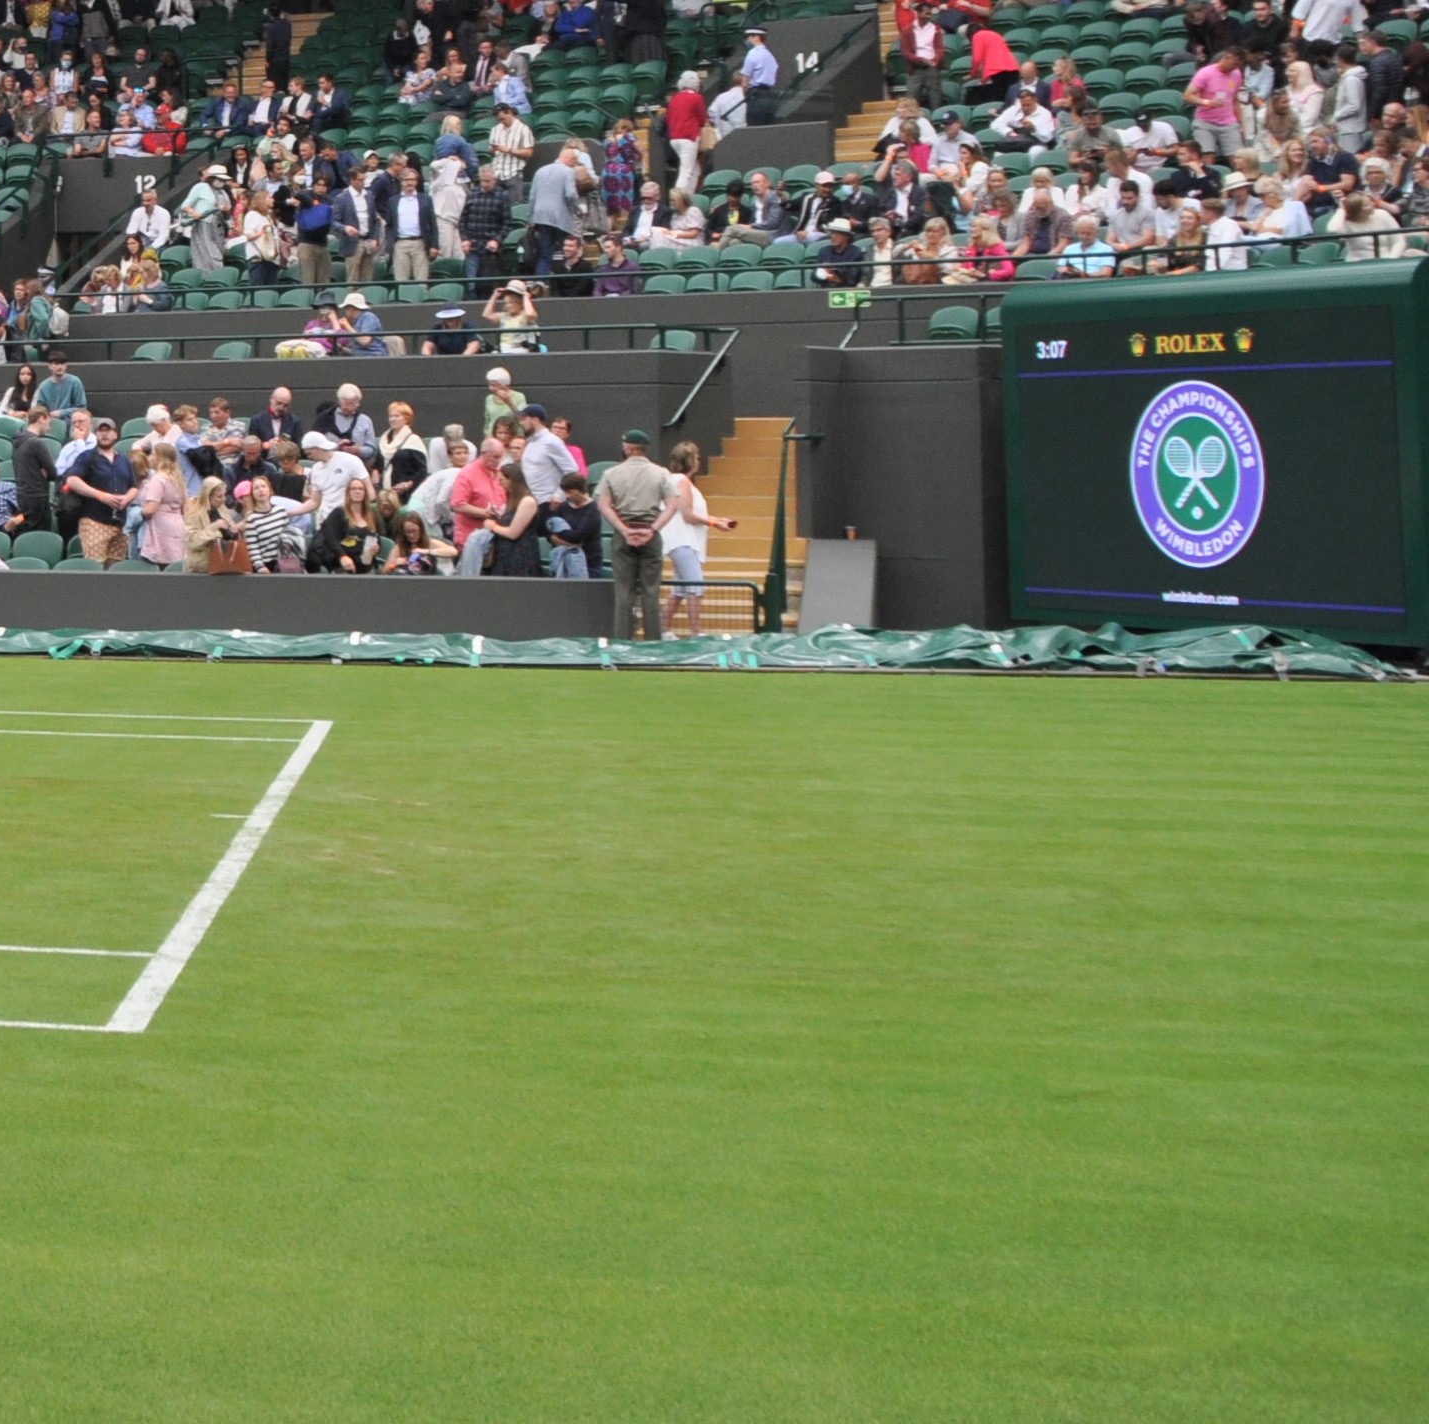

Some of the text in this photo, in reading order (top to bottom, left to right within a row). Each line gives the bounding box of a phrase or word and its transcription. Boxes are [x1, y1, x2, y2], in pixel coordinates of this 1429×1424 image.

[795, 51, 819, 73] 14
[135, 175, 156, 194] 12
[1035, 340, 1068, 360] 3:07
[1155, 332, 1226, 355] ROLEX
[1137, 390, 1256, 469] THE CHAMPIONSHIPS
[1155, 517, 1244, 557] WIMBLEDON
